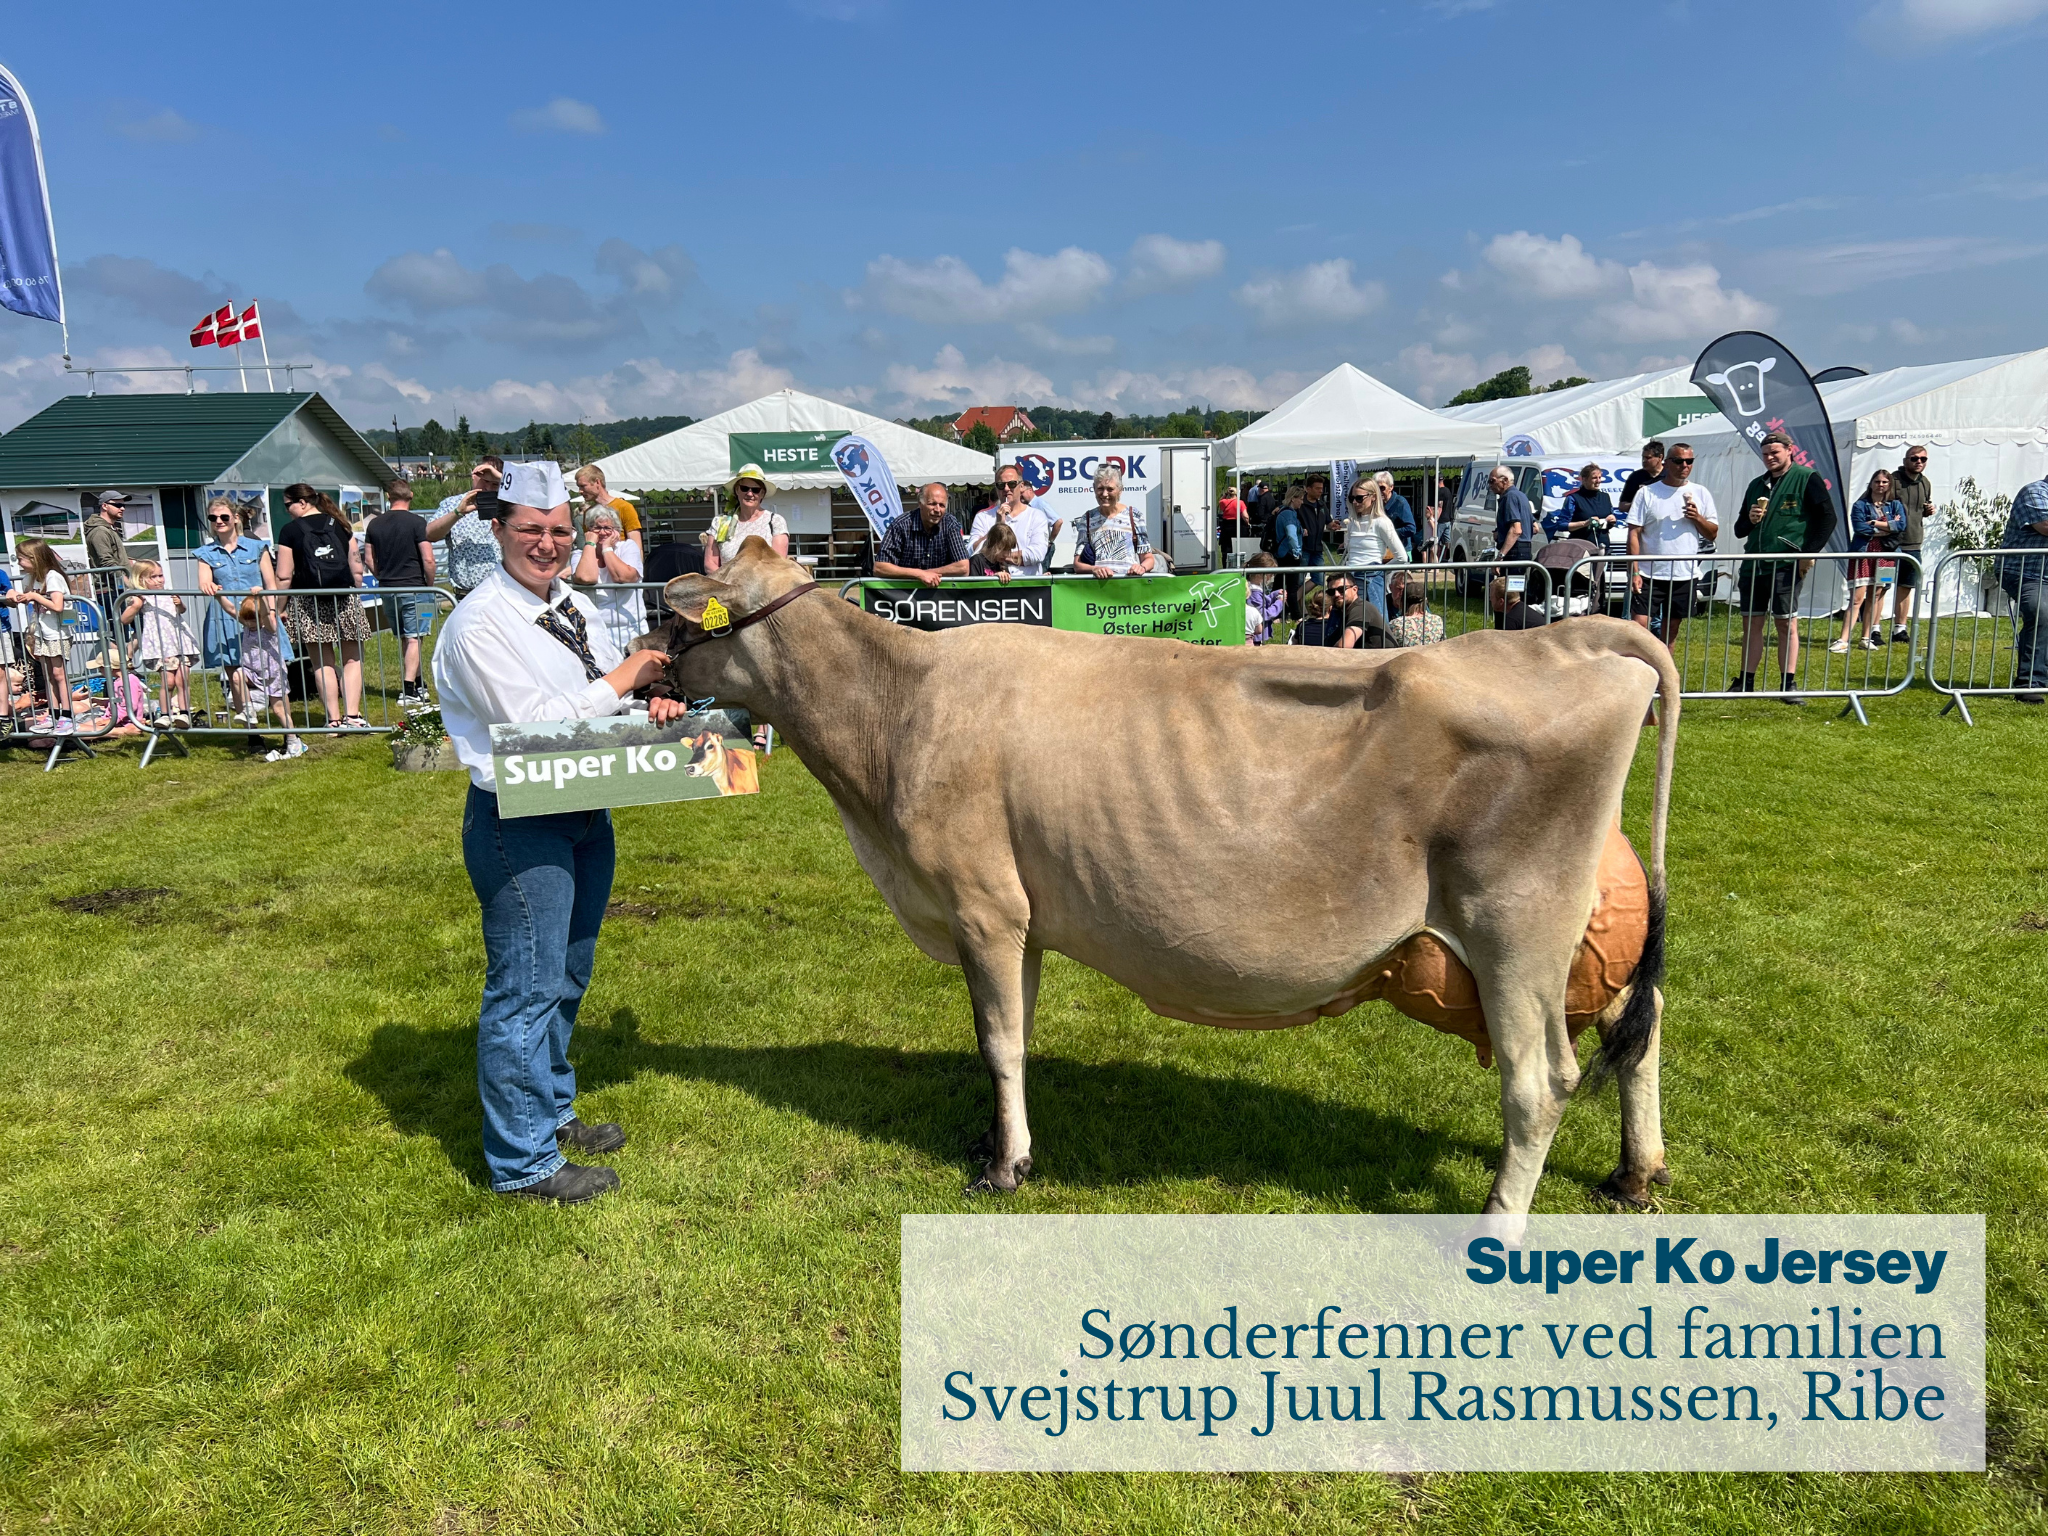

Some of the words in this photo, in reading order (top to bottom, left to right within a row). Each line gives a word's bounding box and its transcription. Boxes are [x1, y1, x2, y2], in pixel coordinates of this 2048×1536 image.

[764, 447, 819, 462] HESTE
[1058, 455, 1147, 481] BCDK
[1121, 484, 1148, 492] nmark
[874, 588, 1043, 623] SØRENSEN
[1086, 599, 1198, 619] Bygmestervej
[1201, 598, 1210, 611] 2
[705, 613, 728, 629] 02283
[1103, 621, 1148, 635] Øster
[1152, 618, 1193, 634] Højst
[504, 753, 617, 789] Super
[626, 745, 677, 774] Ko
